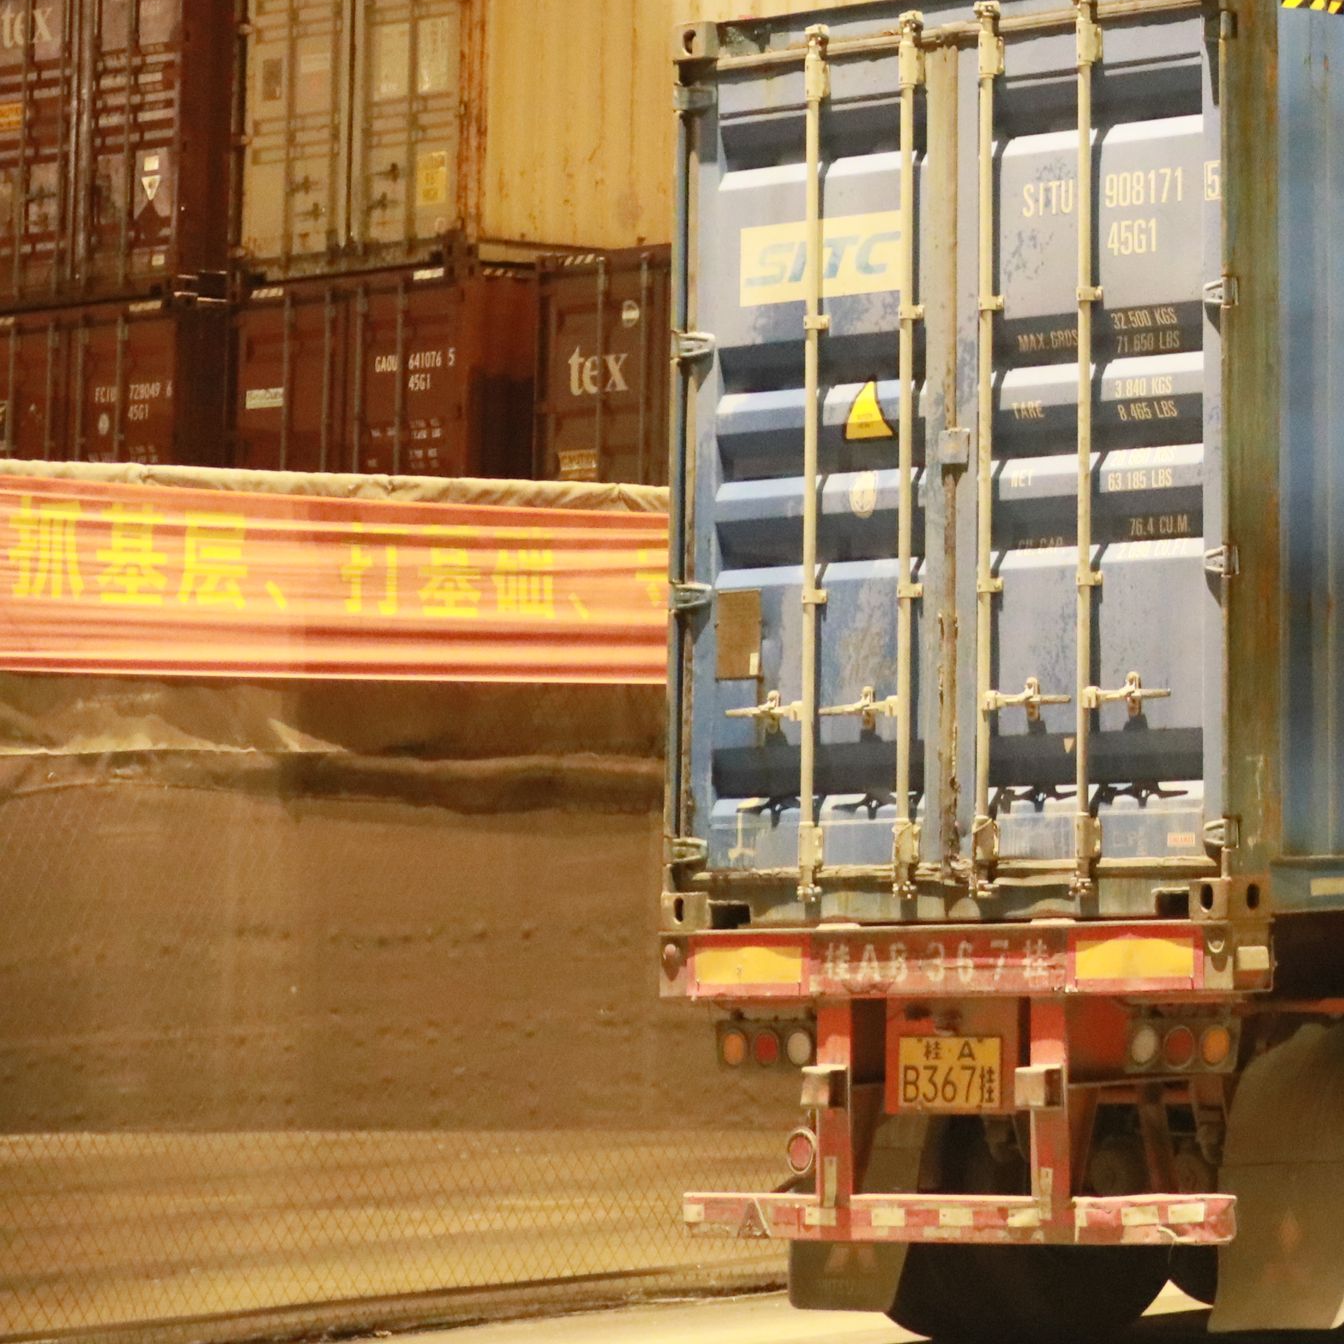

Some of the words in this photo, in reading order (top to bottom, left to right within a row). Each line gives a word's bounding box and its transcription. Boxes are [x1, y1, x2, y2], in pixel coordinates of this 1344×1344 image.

[1022, 179, 1074, 218] SITU
[1104, 167, 1184, 209] 908171
[1205, 161, 1221, 201] 5
[1107, 217, 1157, 256] 45G1
[745, 231, 902, 288] SITC
[1155, 307, 1177, 325] KGS
[1159, 330, 1180, 350] LBS
[408, 351, 442, 370] 641076
[568, 345, 628, 396] tex
[408, 374, 431, 392] 45G1
[1152, 375, 1172, 394] KGS
[128, 405, 149, 421] 45G1
[1012, 400, 1045, 420] TARE
[1156, 400, 1178, 418] LBS
[1010, 468, 1034, 488] NET
[1151, 468, 1173, 488] LBS
[1129, 517, 1155, 537] 76.4
[902, 1065, 996, 1105] B367挂
